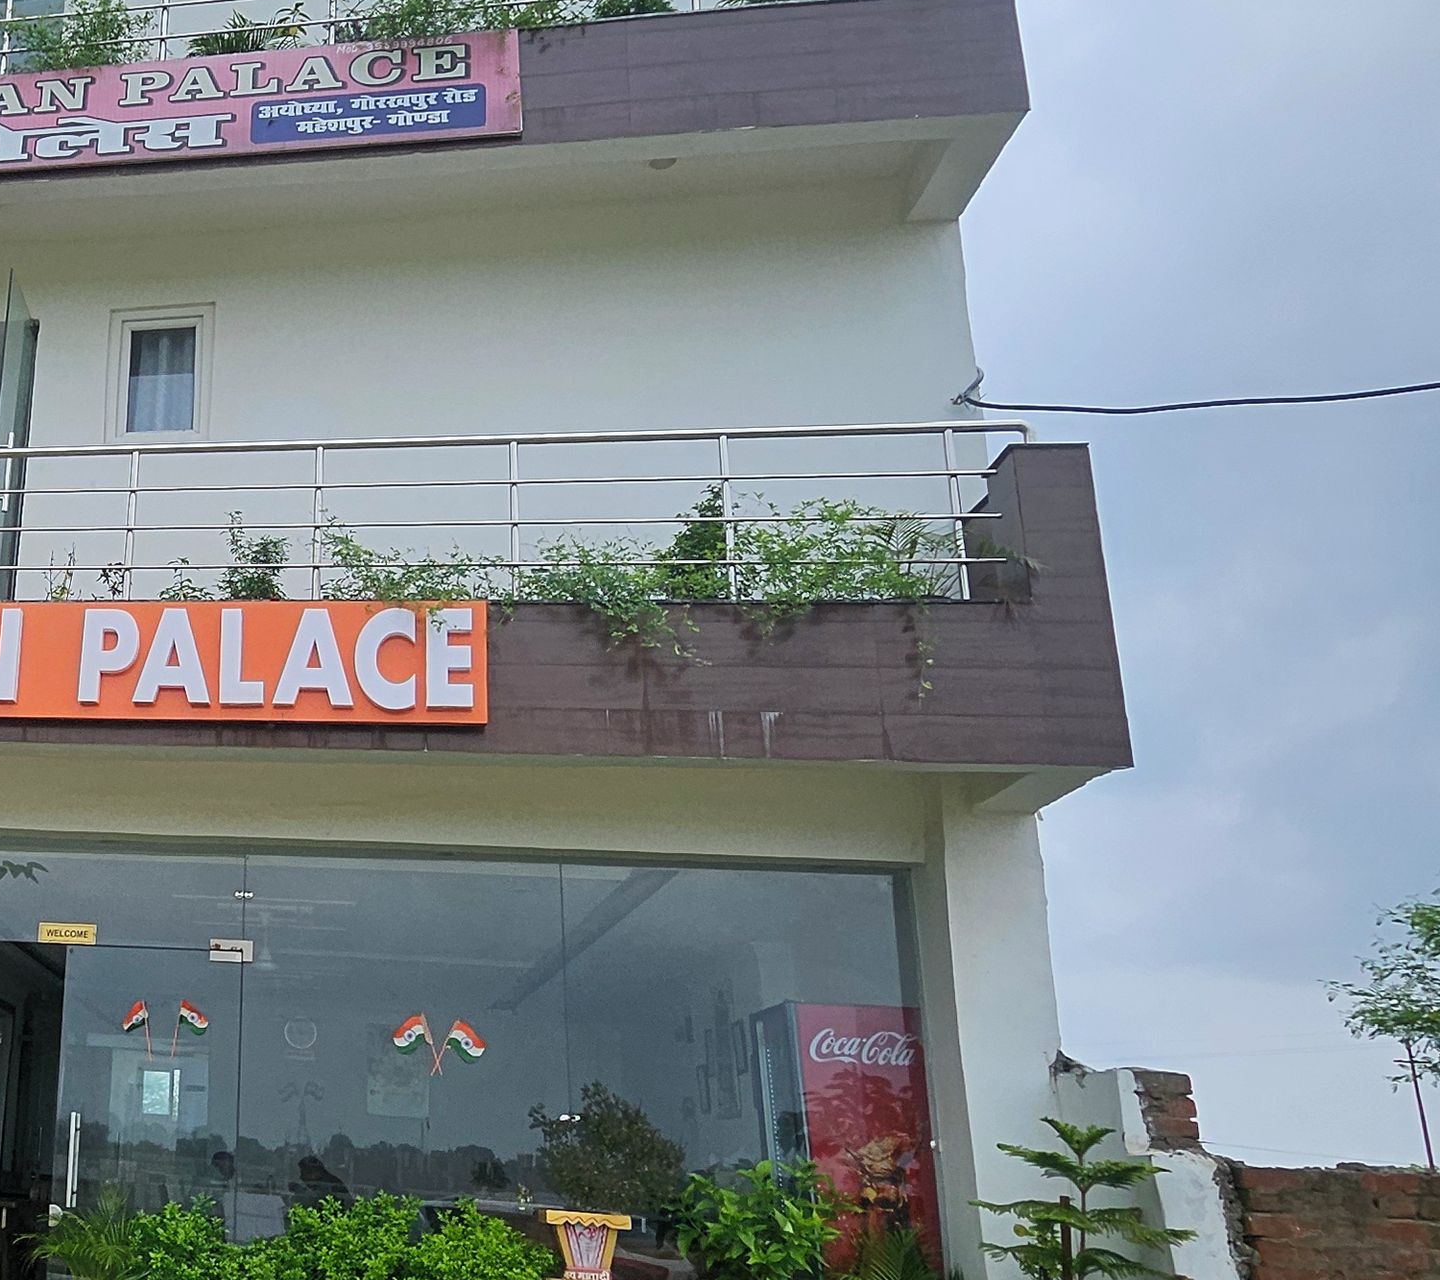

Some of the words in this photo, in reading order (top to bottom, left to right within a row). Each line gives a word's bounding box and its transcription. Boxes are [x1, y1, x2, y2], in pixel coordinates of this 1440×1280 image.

[118, 44, 472, 108] PALACE
[77, 607, 474, 710] PALACE
[46, 929, 89, 938] WELCOME
